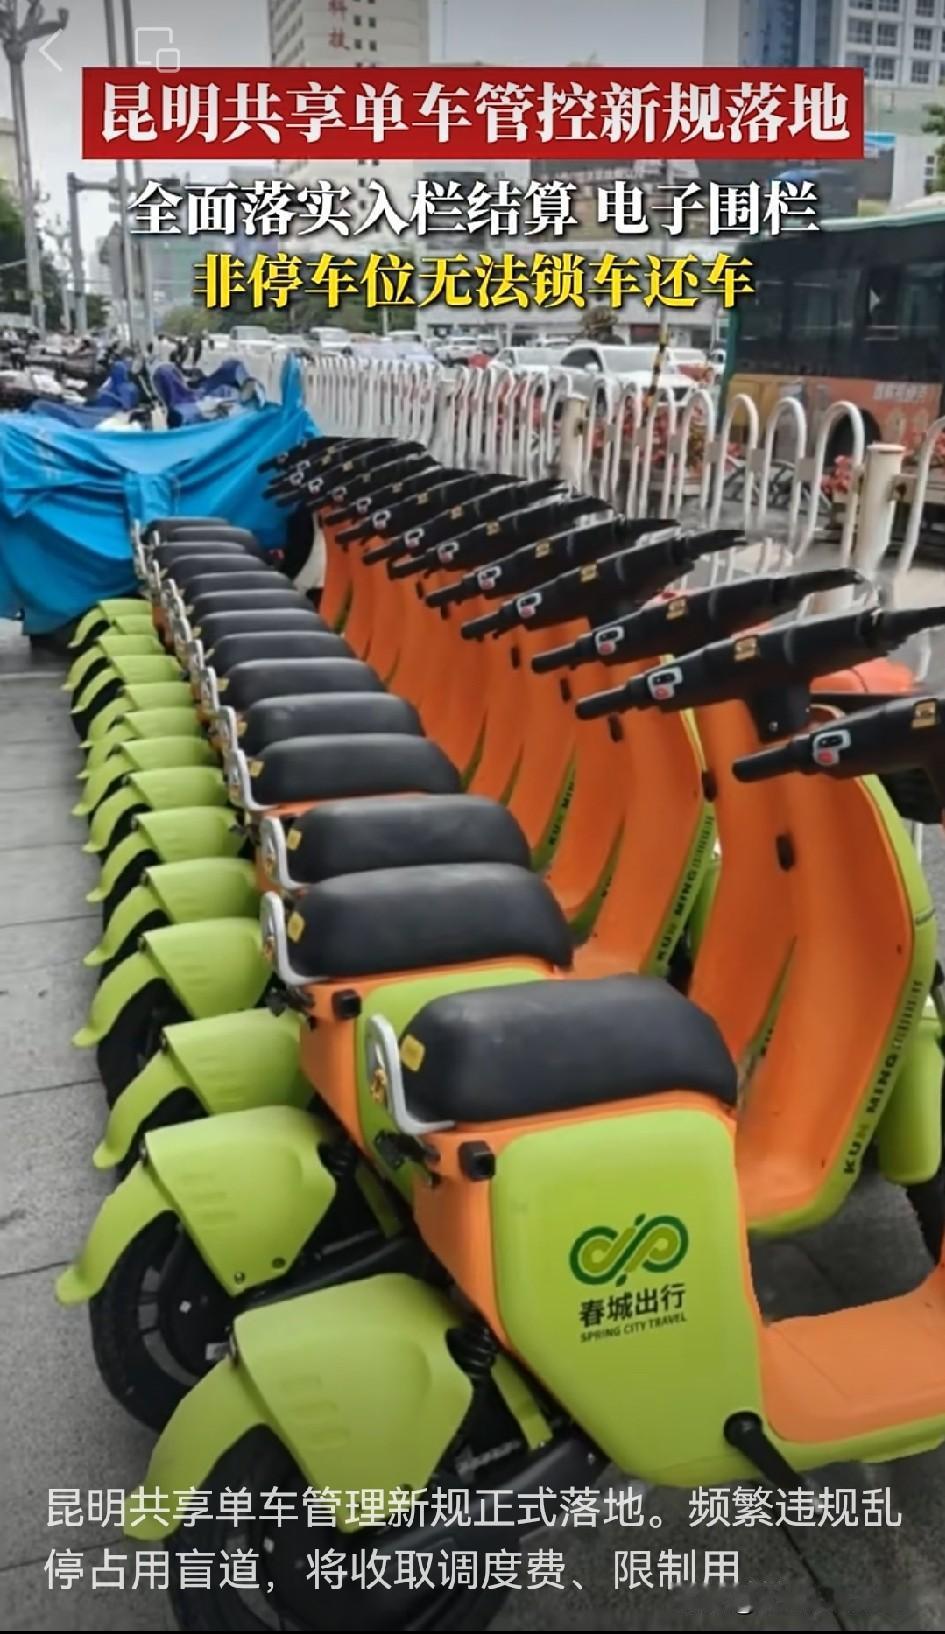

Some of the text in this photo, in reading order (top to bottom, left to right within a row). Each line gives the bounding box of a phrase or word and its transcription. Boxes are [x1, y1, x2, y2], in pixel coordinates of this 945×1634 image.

[866, 1053, 899, 1114] MING
[578, 1282, 686, 1328] 春城出行
[580, 1311, 688, 1344] SPRING CITY TRAVEL
